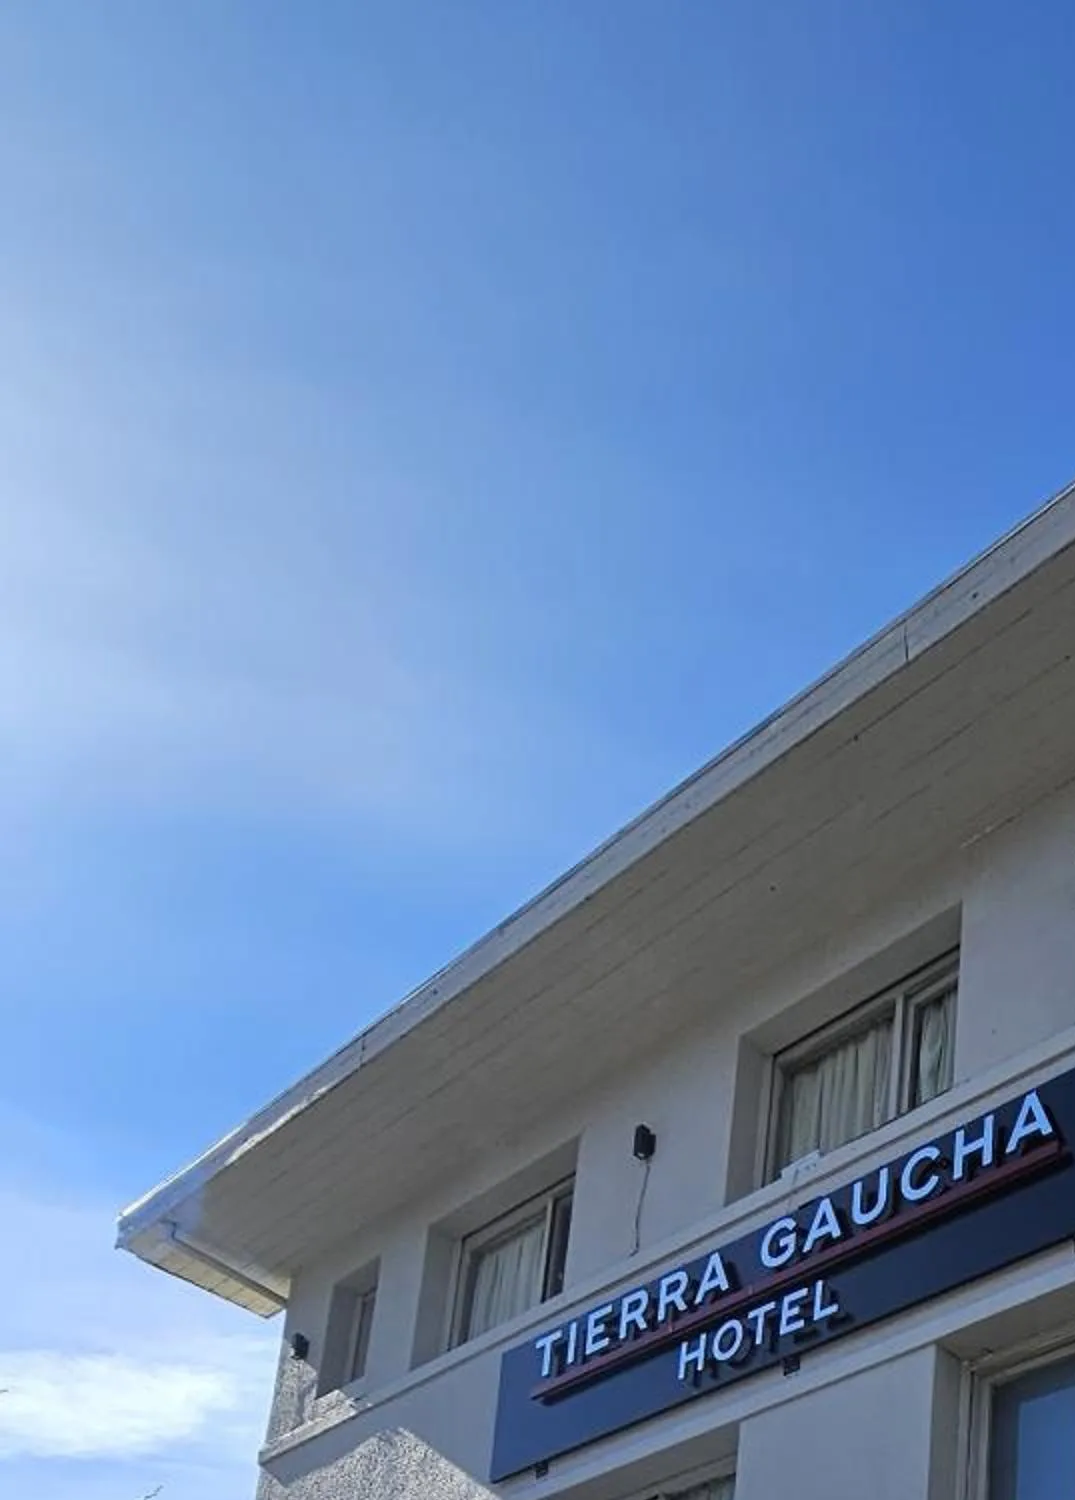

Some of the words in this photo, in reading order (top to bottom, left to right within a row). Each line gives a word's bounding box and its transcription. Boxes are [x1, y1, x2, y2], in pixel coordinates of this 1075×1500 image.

[535, 1252, 729, 1376] TIERRA
[760, 1091, 1054, 1268] GAUCHA
[677, 1280, 839, 1380] HOTEL
